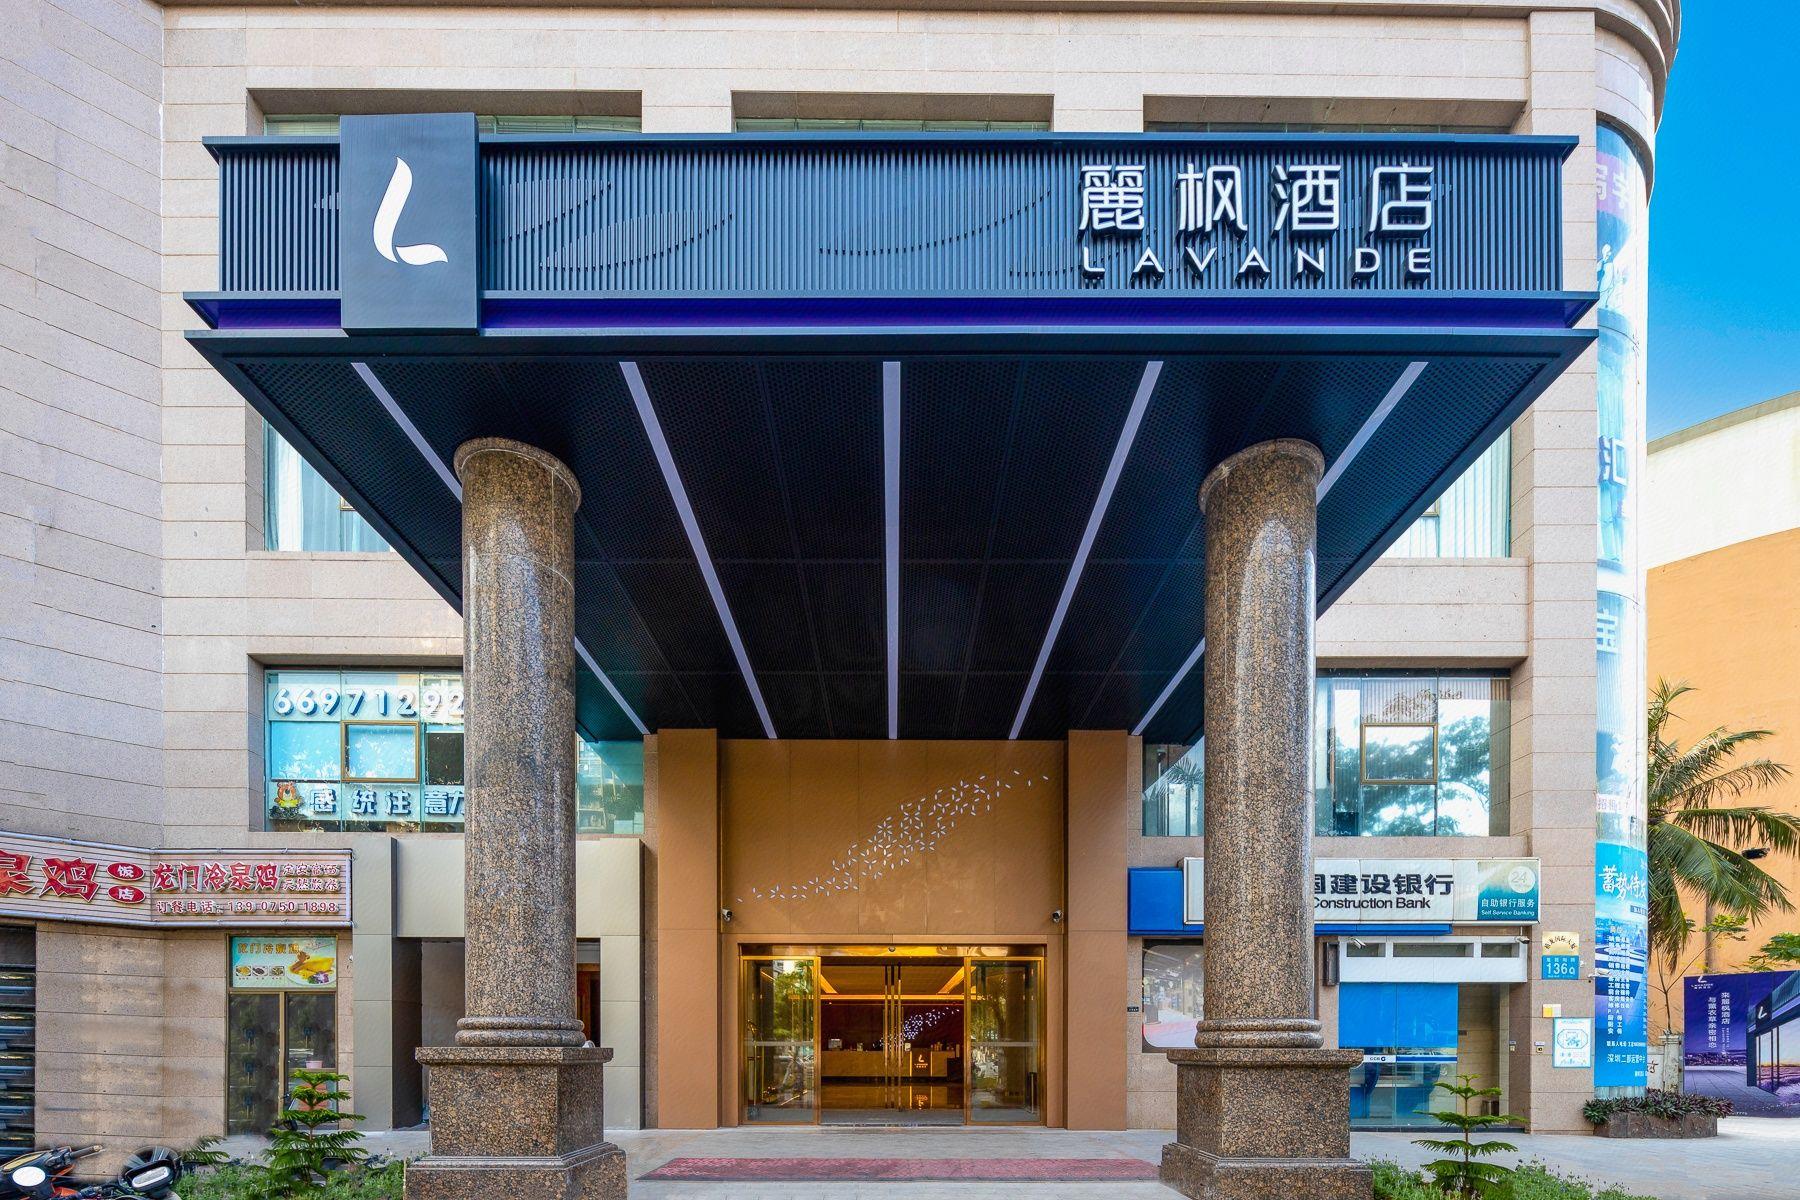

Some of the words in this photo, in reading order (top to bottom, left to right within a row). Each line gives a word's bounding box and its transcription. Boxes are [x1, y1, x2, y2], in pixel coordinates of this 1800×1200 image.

[1079, 161, 1437, 233] 麗枫酒店
[1082, 246, 1432, 273] LAVANDE
[310, 788, 464, 815] 感统注意力
[152, 861, 280, 892] 龙门冷泉鸡
[228, 902, 254, 912] 139
[261, 901, 297, 912] 0750
[303, 902, 337, 913] 1898
[1396, 897, 1431, 909] Bank
[1481, 898, 1535, 908] 自助银行服务
